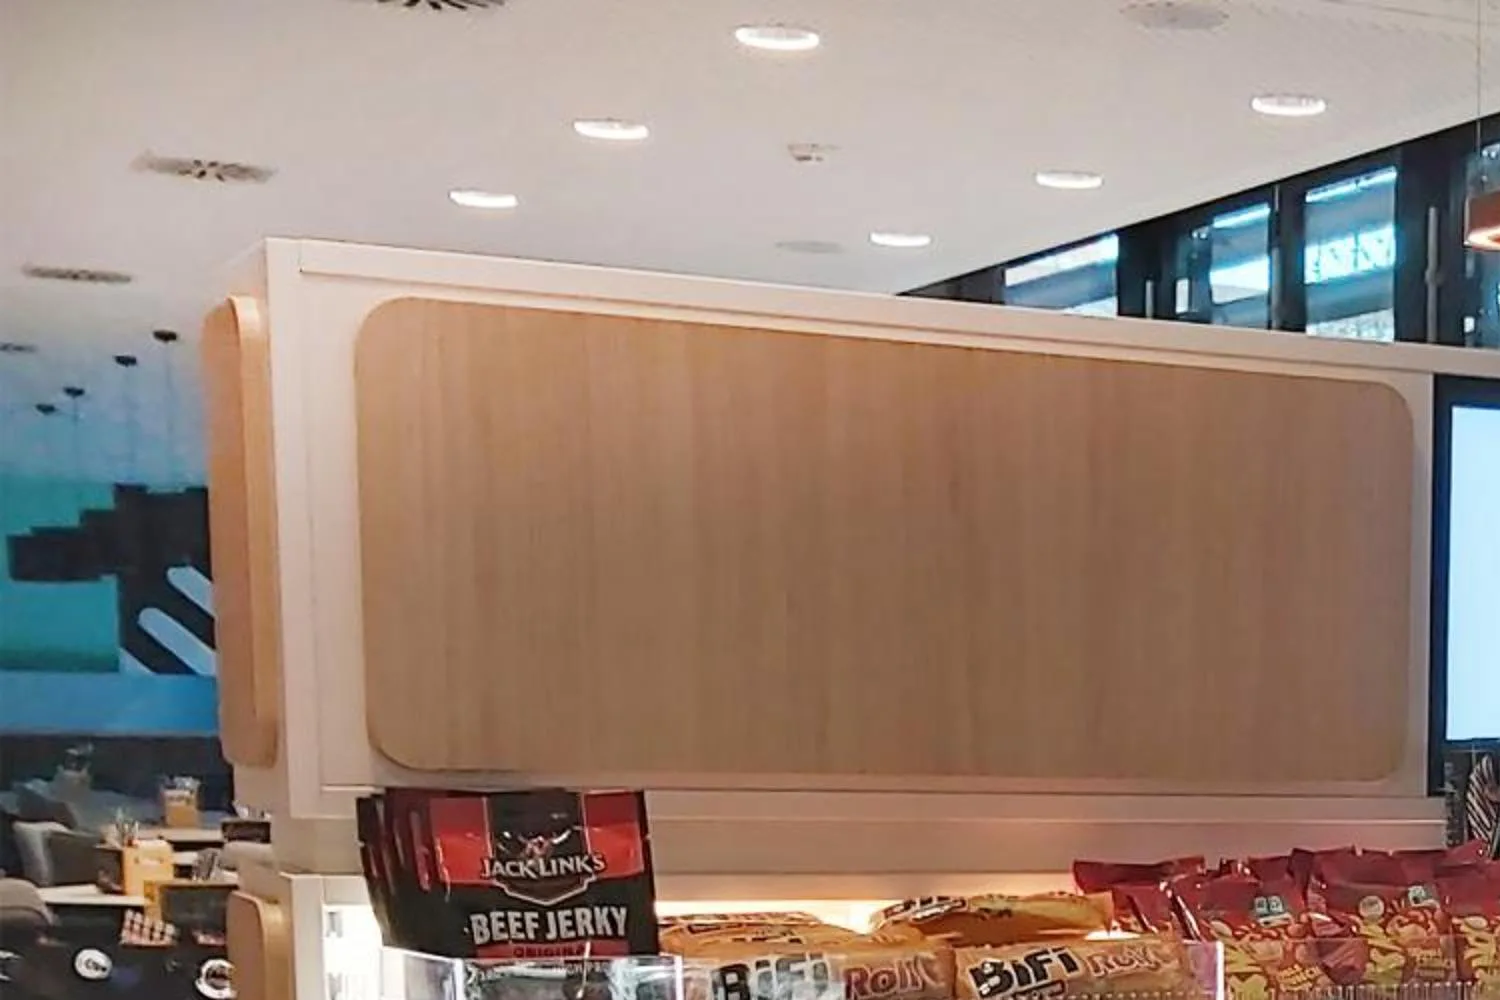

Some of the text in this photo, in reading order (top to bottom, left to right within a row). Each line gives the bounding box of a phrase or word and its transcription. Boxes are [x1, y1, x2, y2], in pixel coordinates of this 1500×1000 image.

[480, 857, 538, 879] JACK
[470, 906, 628, 945] BEEF JERKY
